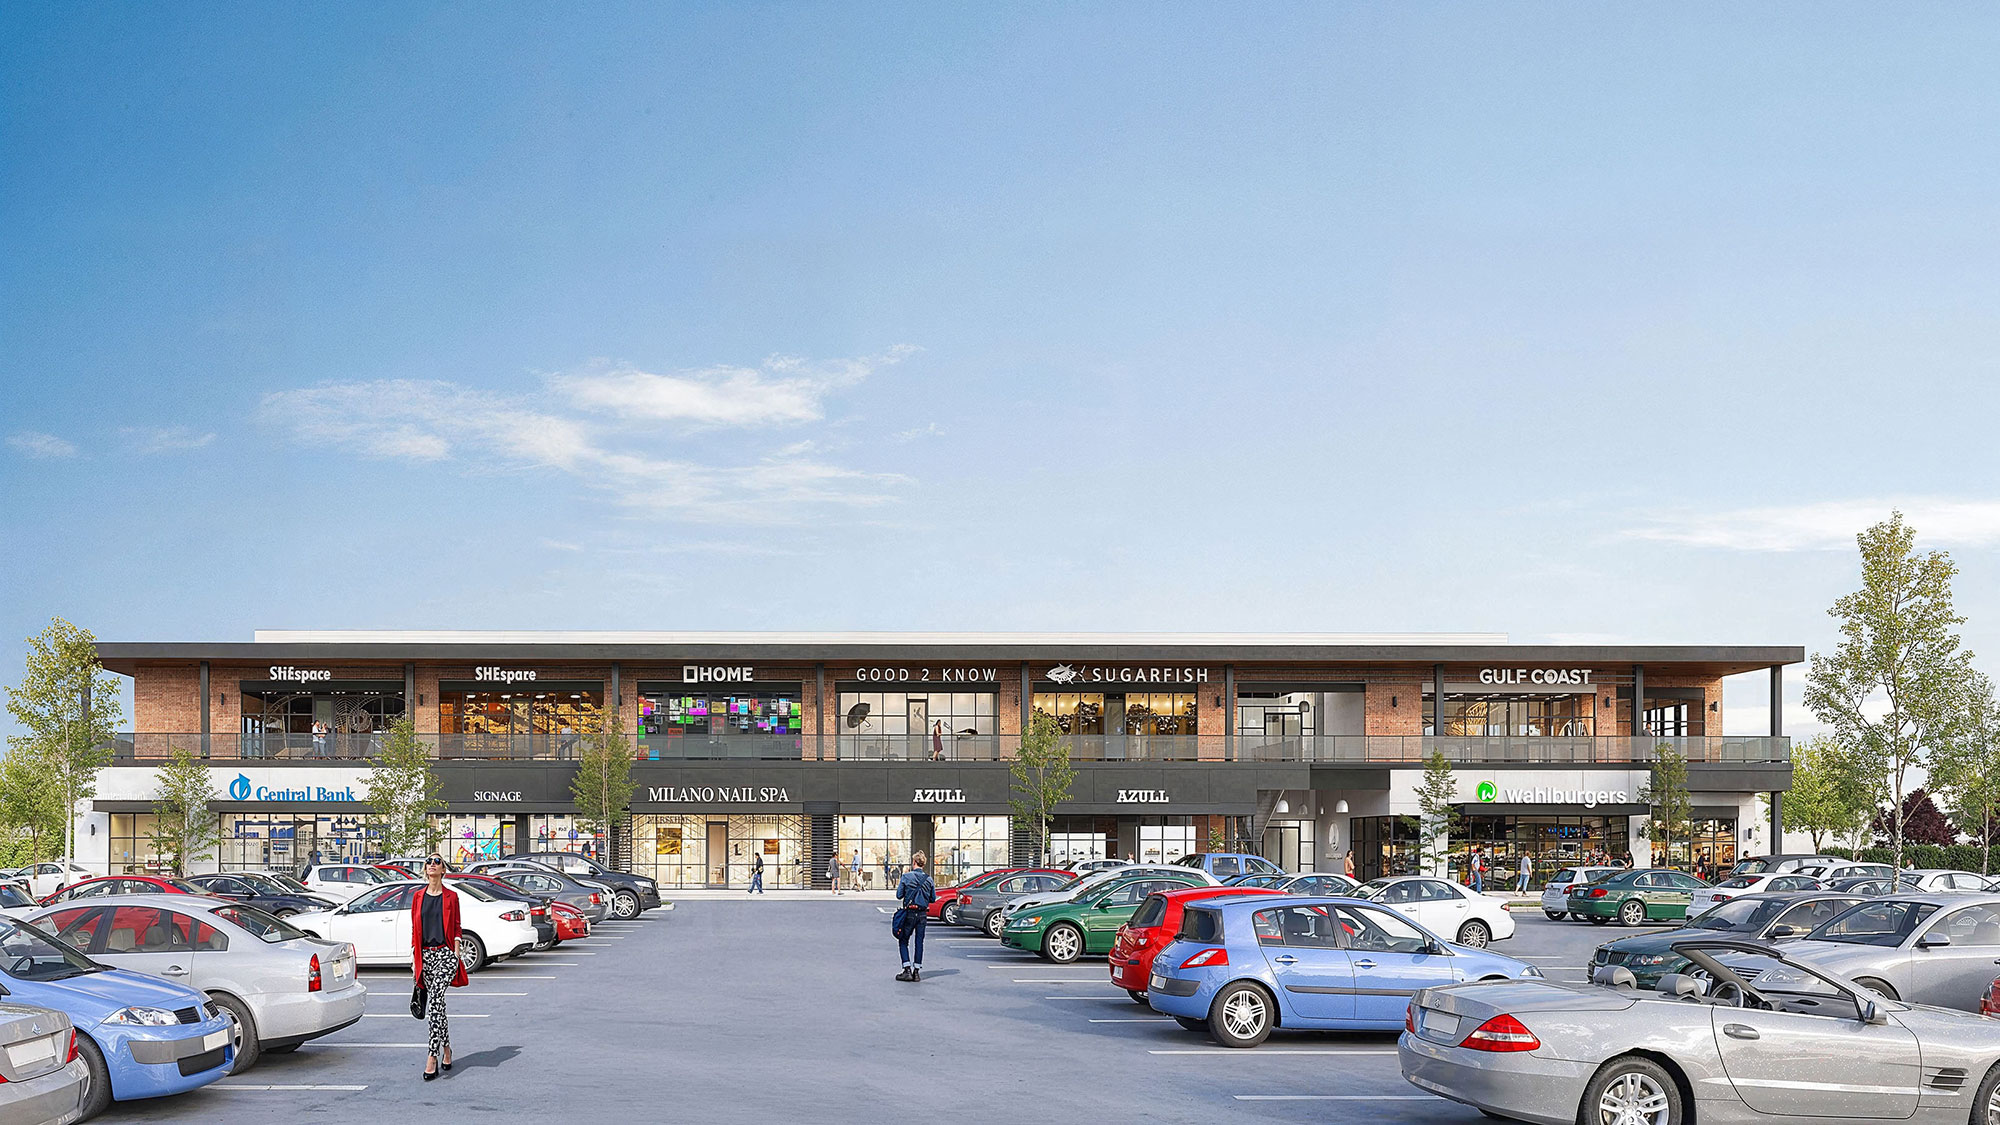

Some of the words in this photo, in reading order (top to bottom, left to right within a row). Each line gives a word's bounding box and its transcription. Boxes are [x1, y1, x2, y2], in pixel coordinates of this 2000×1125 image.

[699, 667, 753, 682] HOME
[856, 668, 909, 682] GOOD
[921, 668, 930, 681] 2
[942, 668, 997, 682] KNOW
[1092, 667, 1208, 683] SUGARFISH
[1479, 668, 1527, 684] GULF
[1530, 668, 1592, 685] COAST
[315, 786, 356, 802] Bank
[473, 790, 523, 802] SIGNAGE
[648, 787, 715, 802] MILANO
[717, 787, 757, 802] NAIL
[759, 787, 790, 802] SPA
[912, 789, 966, 803] AZULL
[1116, 789, 1170, 803] AZULL
[1504, 787, 1628, 809] wahlburgers
